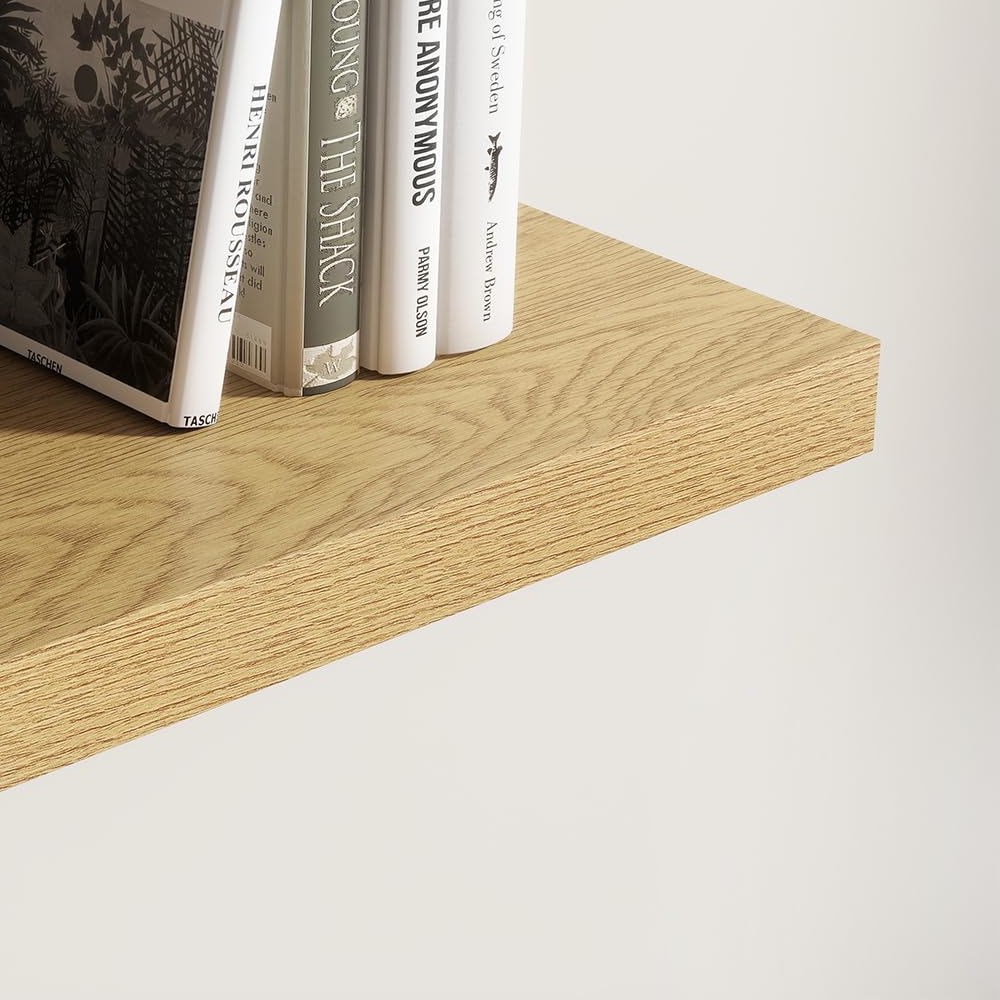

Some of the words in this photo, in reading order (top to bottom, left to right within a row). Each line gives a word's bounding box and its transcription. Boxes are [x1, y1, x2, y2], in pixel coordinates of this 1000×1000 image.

[491, 24, 506, 41] of
[488, 44, 506, 115] Sweden
[240, 85, 266, 170] HENRI
[410, 40, 441, 207] ANONYMOUS
[320, 121, 361, 193] THE
[217, 180, 252, 324] ROUSSEAU
[319, 196, 360, 308] SHACK
[417, 246, 431, 292] PARMY
[485, 221, 498, 273] Andrew
[248, 276, 263, 290] did
[482, 277, 496, 323] Brown
[415, 295, 429, 338] OLSON
[27, 349, 64, 375] TASCHEN
[184, 412, 219, 427] TASCH
